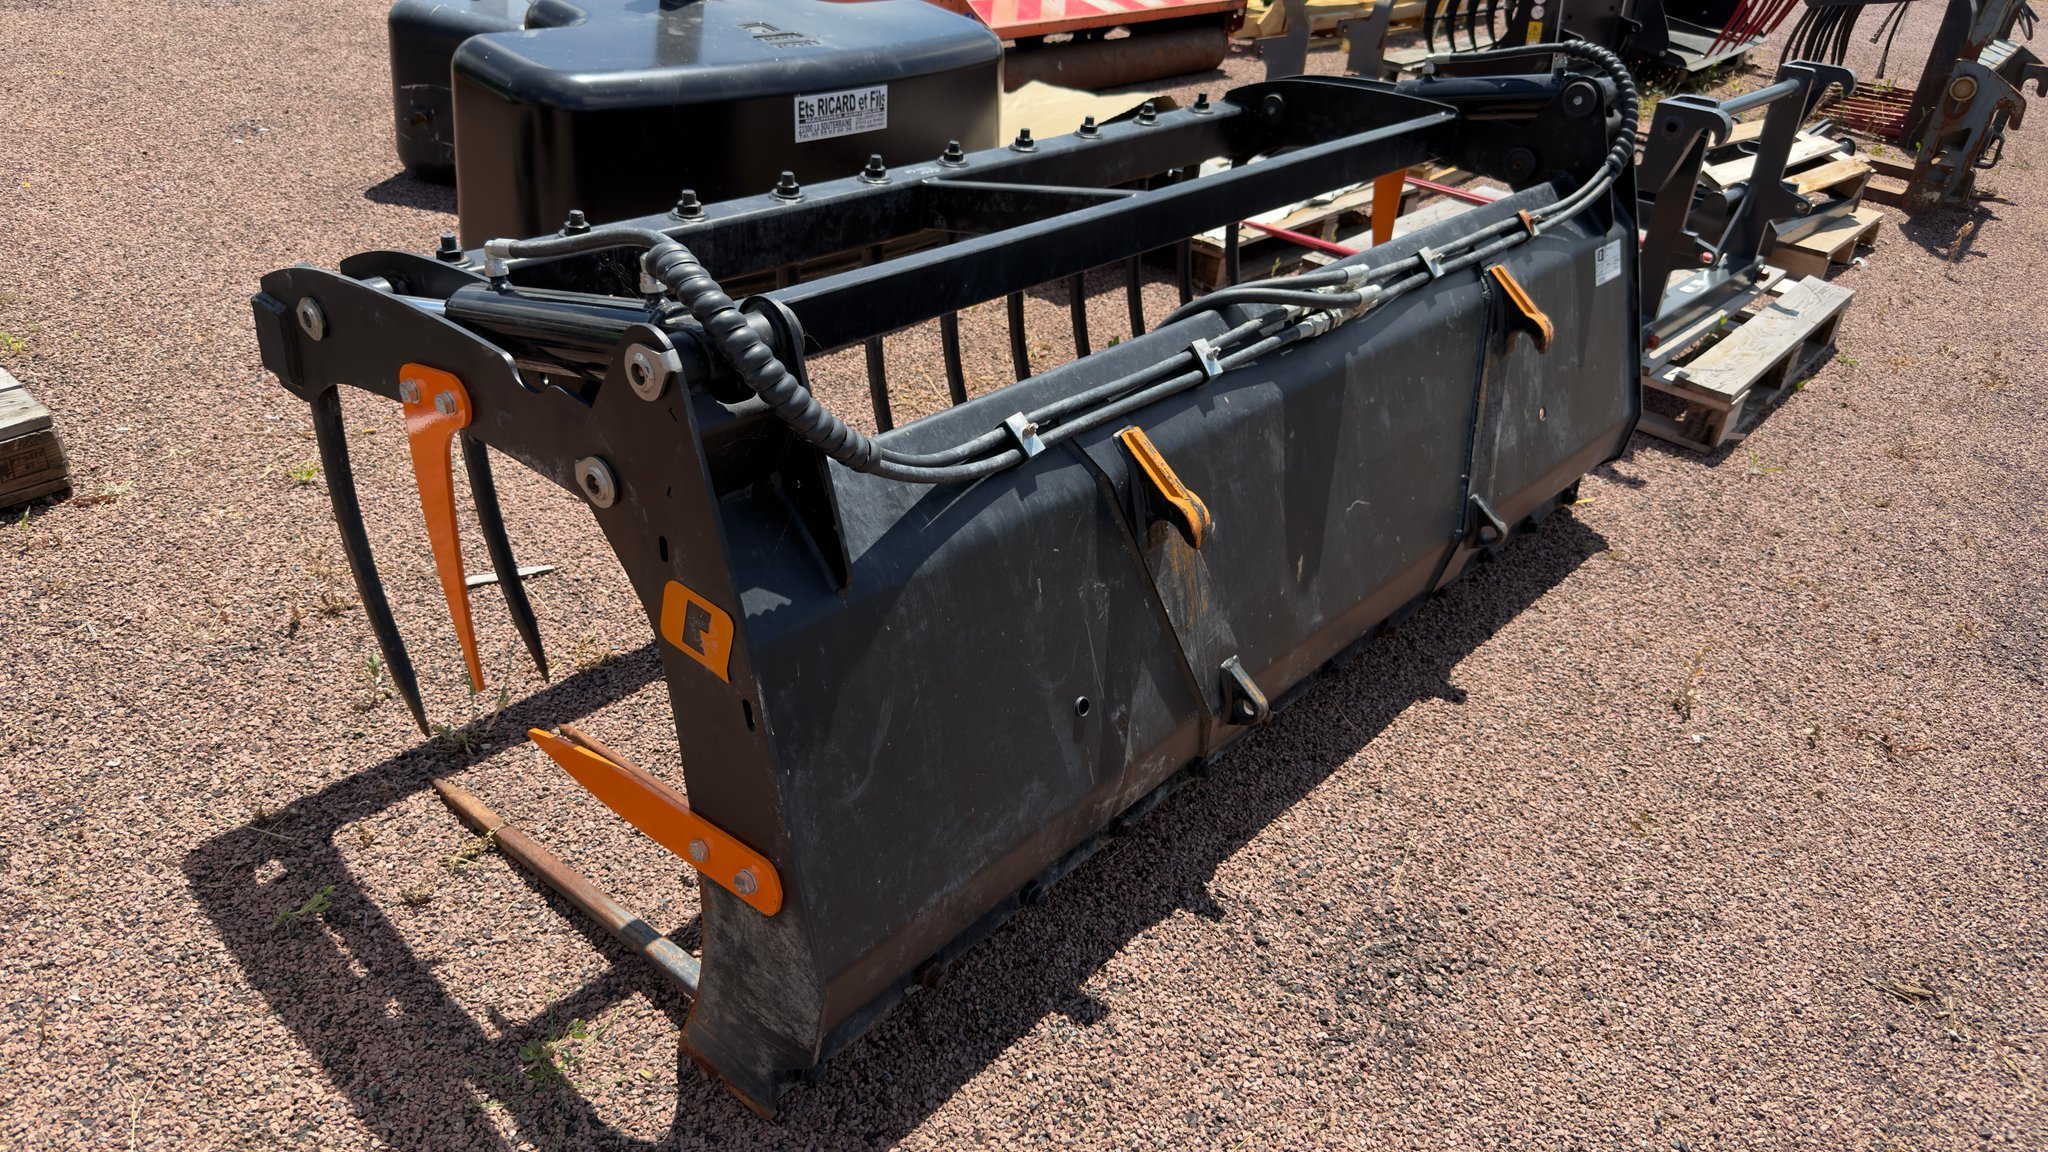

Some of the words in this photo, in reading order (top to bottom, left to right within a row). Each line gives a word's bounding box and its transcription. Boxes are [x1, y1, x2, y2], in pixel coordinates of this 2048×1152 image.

[798, 100, 814, 119] Ets
[817, 94, 856, 116] RICARD
[858, 93, 868, 110] et
[870, 90, 885, 108] Fils
[820, 118, 852, 130] SOUTERRAINE
